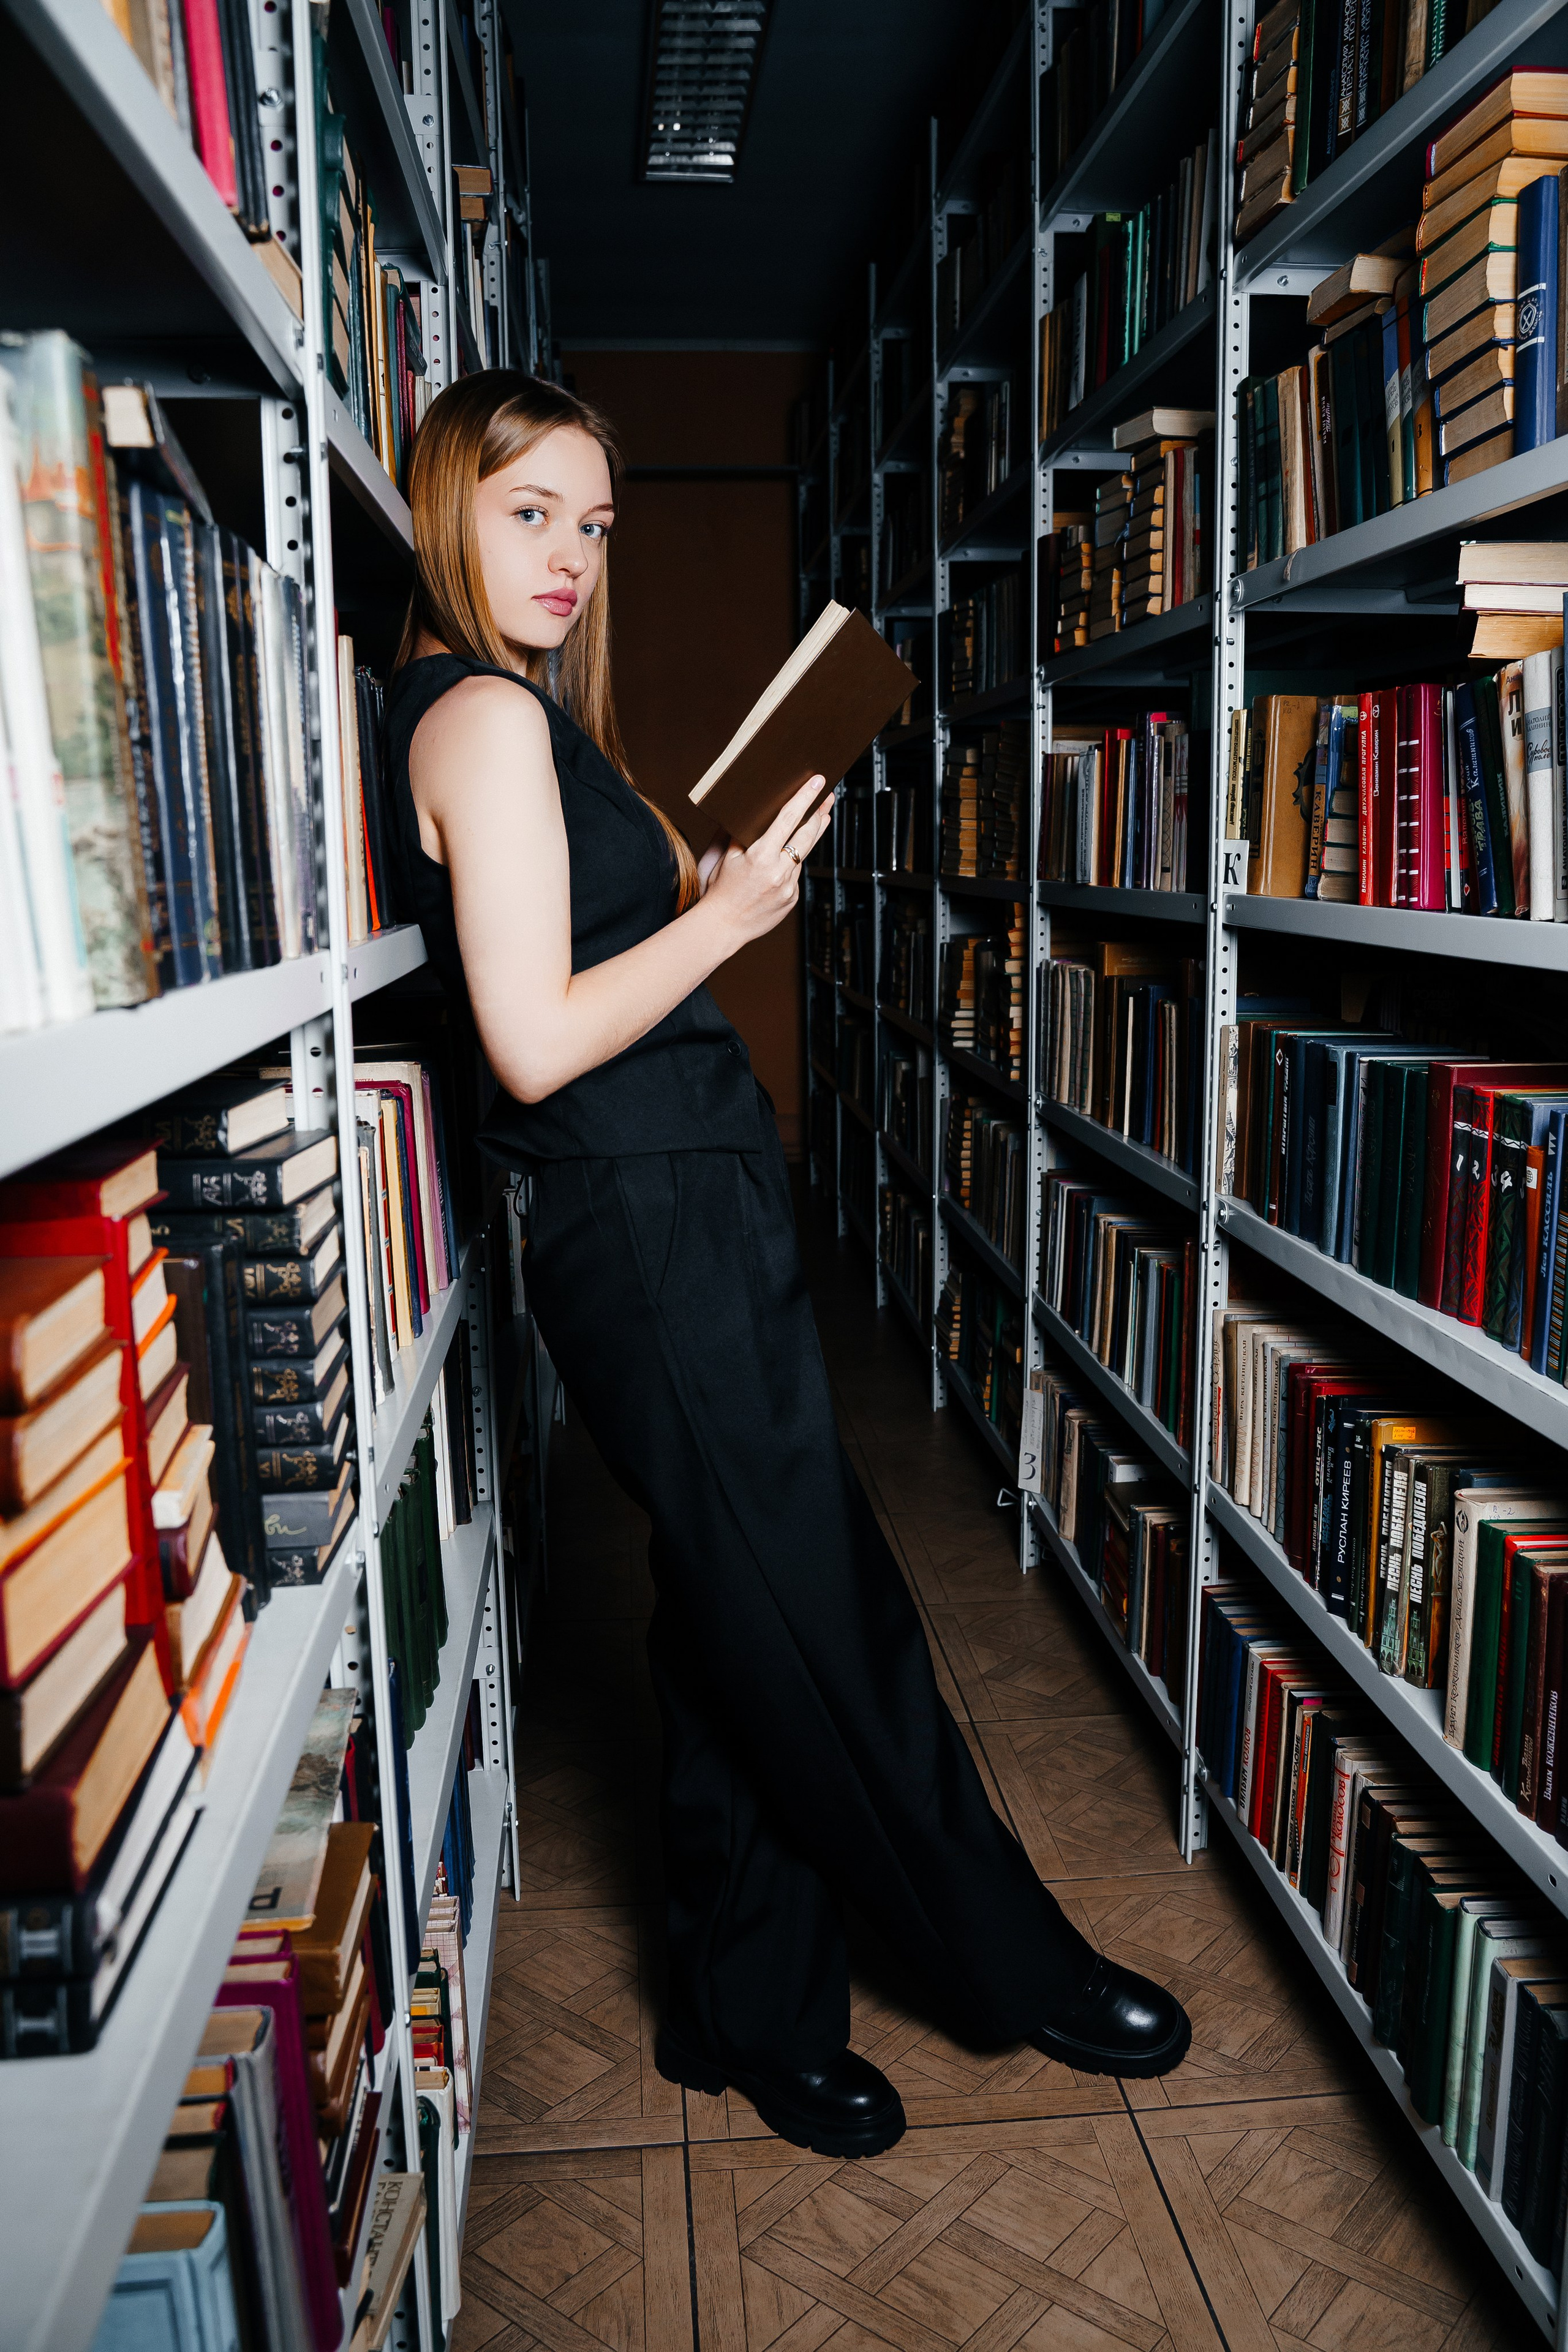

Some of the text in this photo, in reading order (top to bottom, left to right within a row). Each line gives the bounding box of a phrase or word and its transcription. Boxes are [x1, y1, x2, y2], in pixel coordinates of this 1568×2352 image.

[1340, 44, 1349, 97] АНАТОЛИЙ
[1466, 728, 1480, 789] Калашников
[1534, 753, 1551, 763] поле
[1311, 791, 1321, 870] КАВЕРИН
[1474, 798, 1487, 851] ТРАВА
[1496, 772, 1509, 837] КАЛИНИН
[1223, 852, 1242, 886] К
[1456, 1154, 1464, 1172] 1
[1472, 1159, 1480, 1180] 2
[1539, 1171, 1554, 1278] Лев КАССИЛЬ
[1337, 1460, 1352, 1564] РУСЛАН КИРЕЕВ
[1387, 1470, 1408, 1593] ПЕСНЬ ПОБЕДИТЕЛЯ
[1409, 1480, 1427, 1604] ПЕСНЬ ПОБЕДИТЕЛЯ
[1242, 1726, 1251, 1766] КОЗЛОВ
[1542, 1689, 1558, 1801] Вадим КОЖЕВНИКОВ
[1239, 1766, 1249, 1809] ВИЛЬЯМ
[1335, 1779, 1346, 1841] КОЛОСОВ
